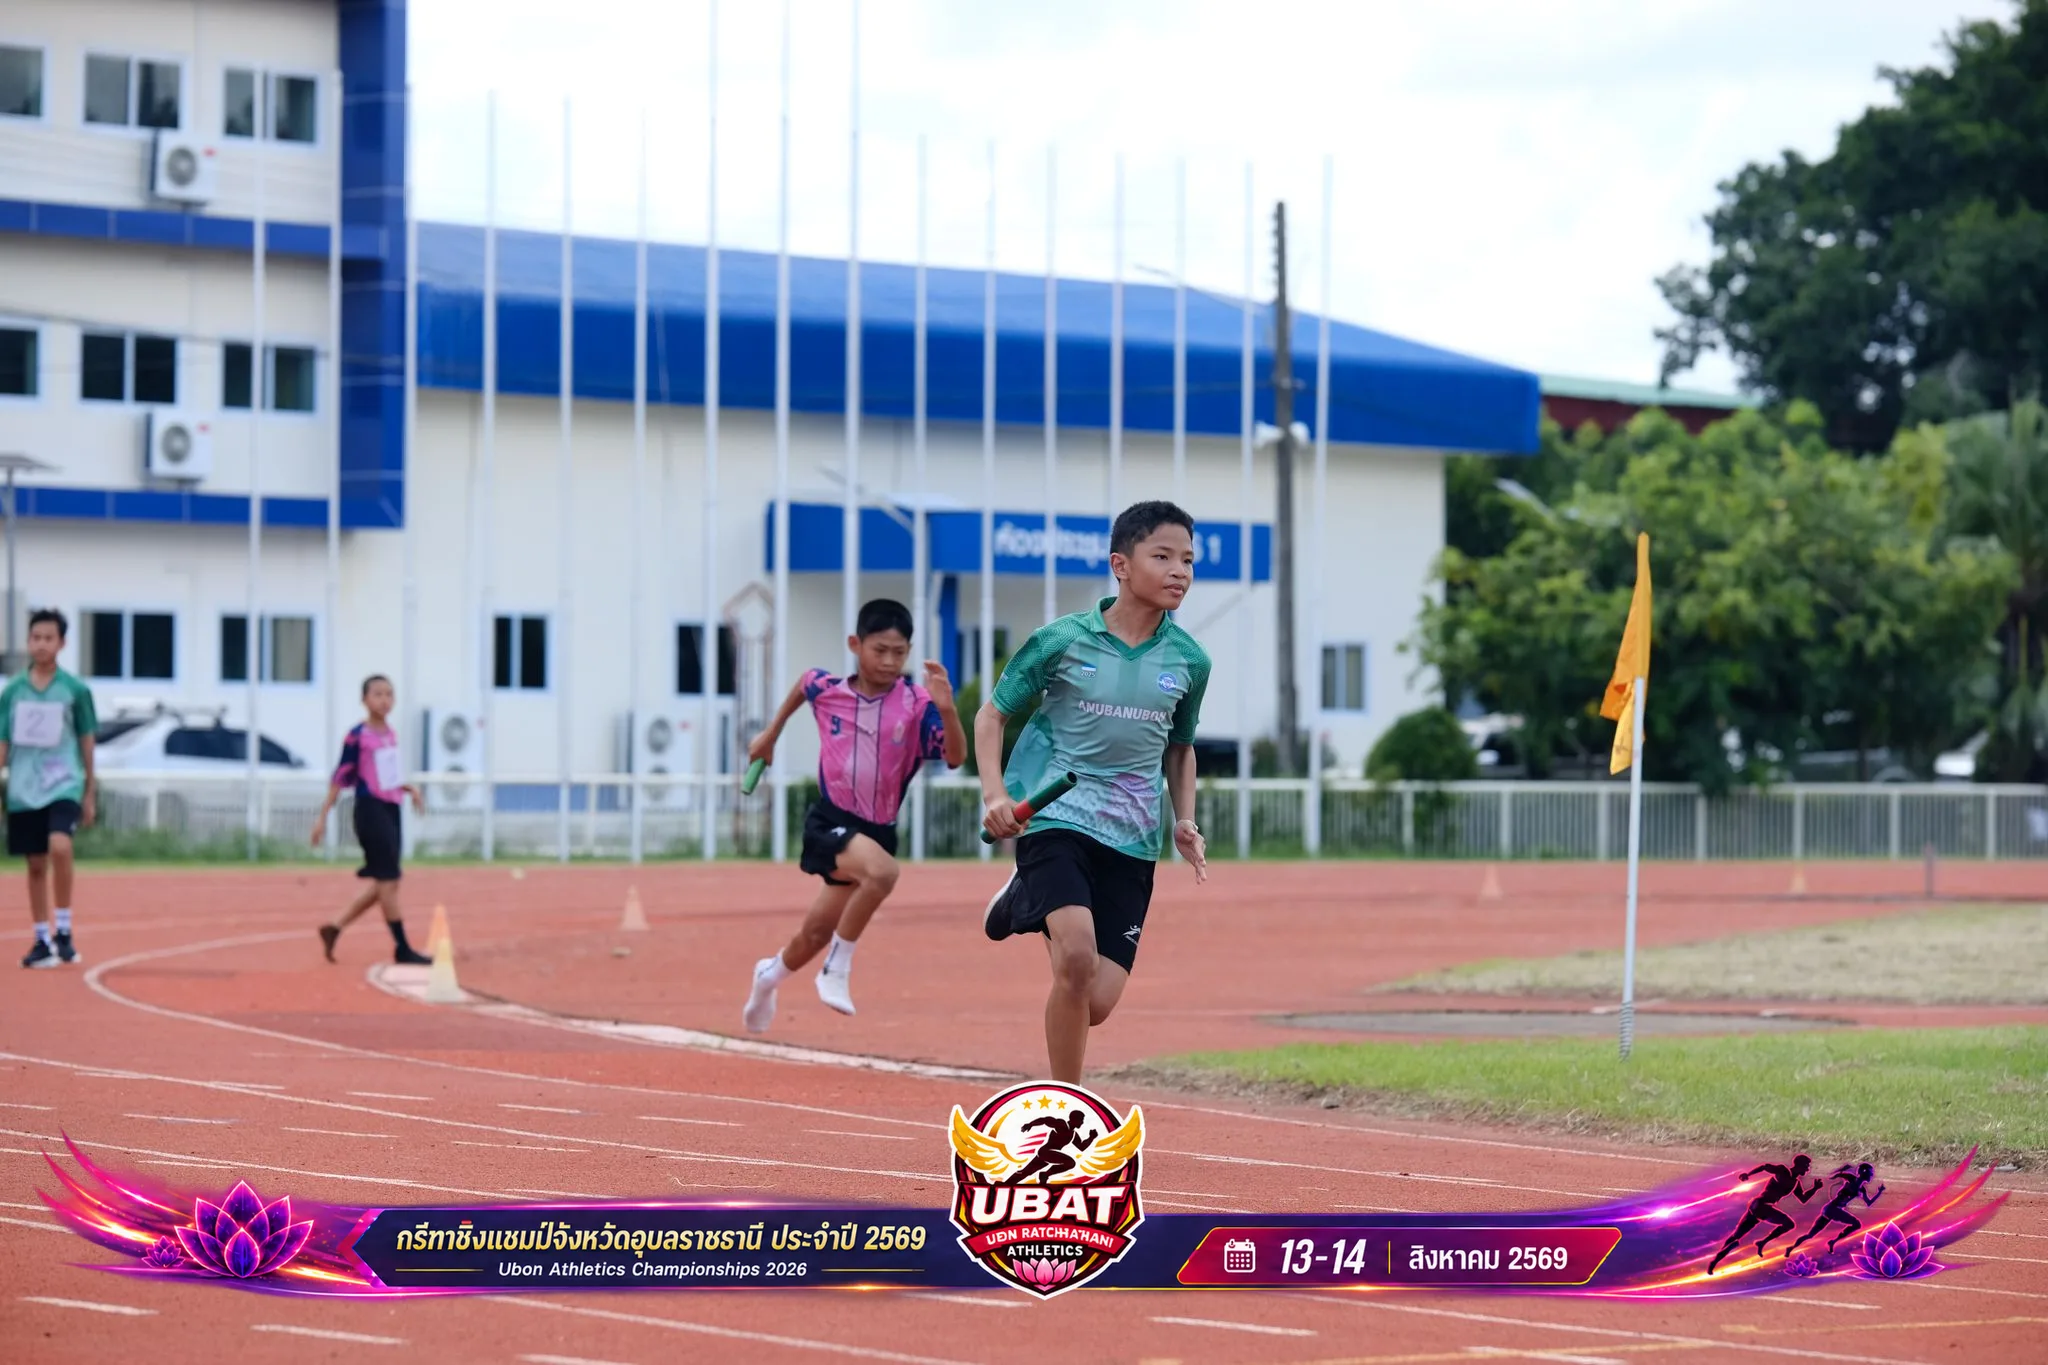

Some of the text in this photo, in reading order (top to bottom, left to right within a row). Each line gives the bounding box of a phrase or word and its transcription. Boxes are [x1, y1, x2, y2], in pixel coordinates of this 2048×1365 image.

[1079, 699, 1167, 721] ANUBANUBON
[25, 708, 47, 738] 2
[831, 715, 841, 735] 9
